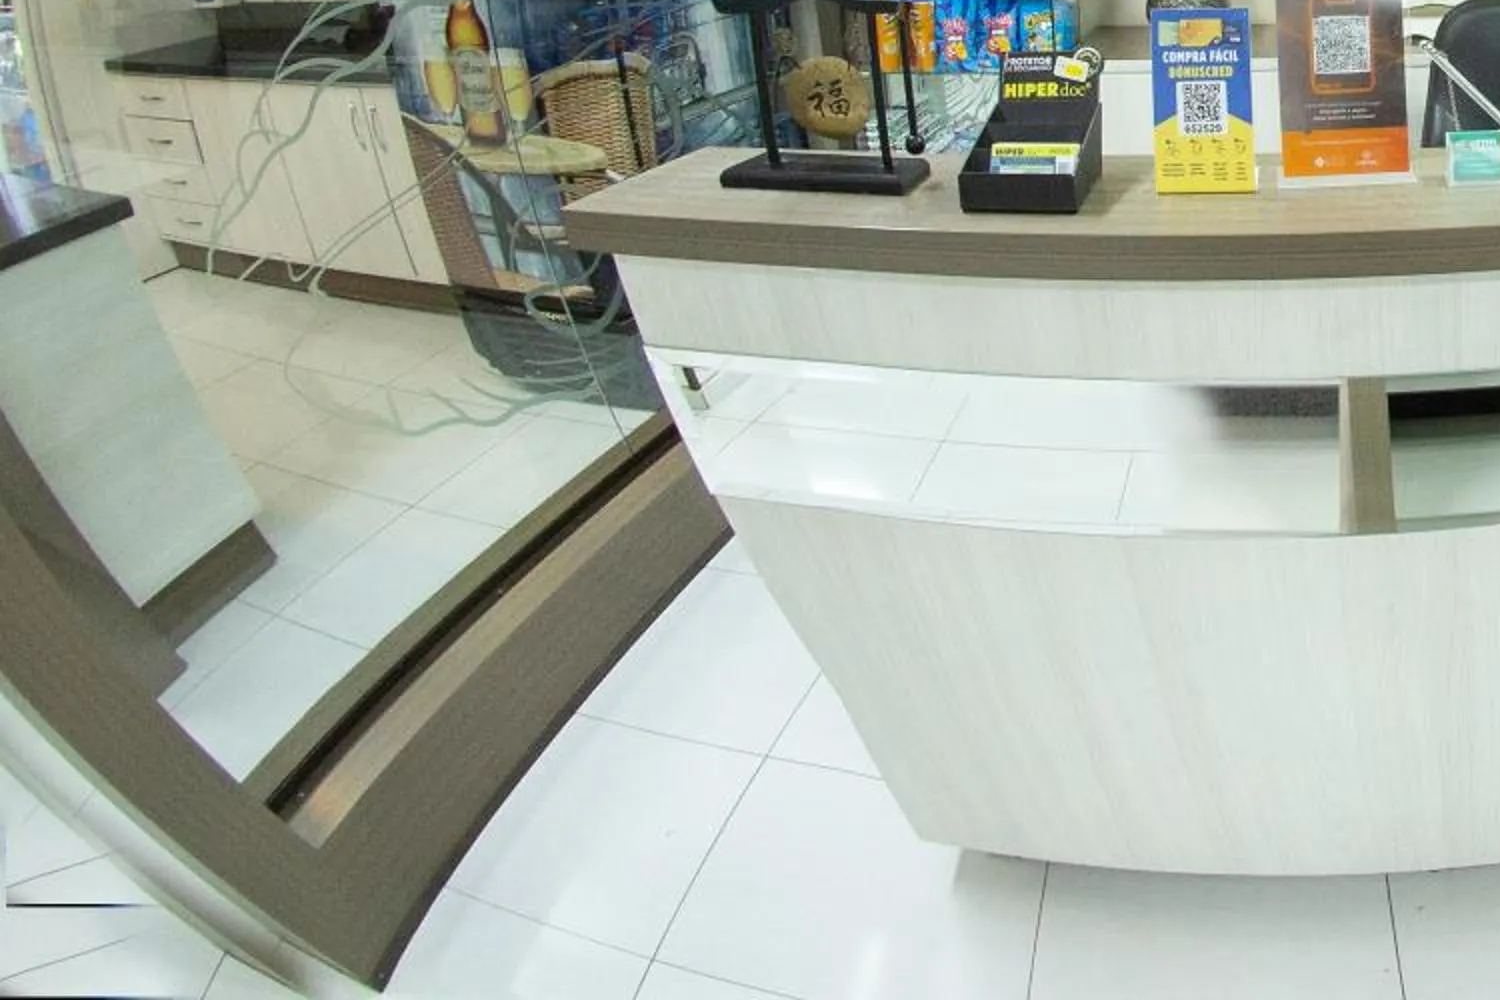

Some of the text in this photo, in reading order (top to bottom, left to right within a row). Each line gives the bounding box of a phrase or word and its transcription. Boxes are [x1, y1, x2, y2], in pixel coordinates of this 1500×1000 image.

[1162, 48, 1238, 63] COMPRA FÁCIL
[807, 79, 851, 118] 福
